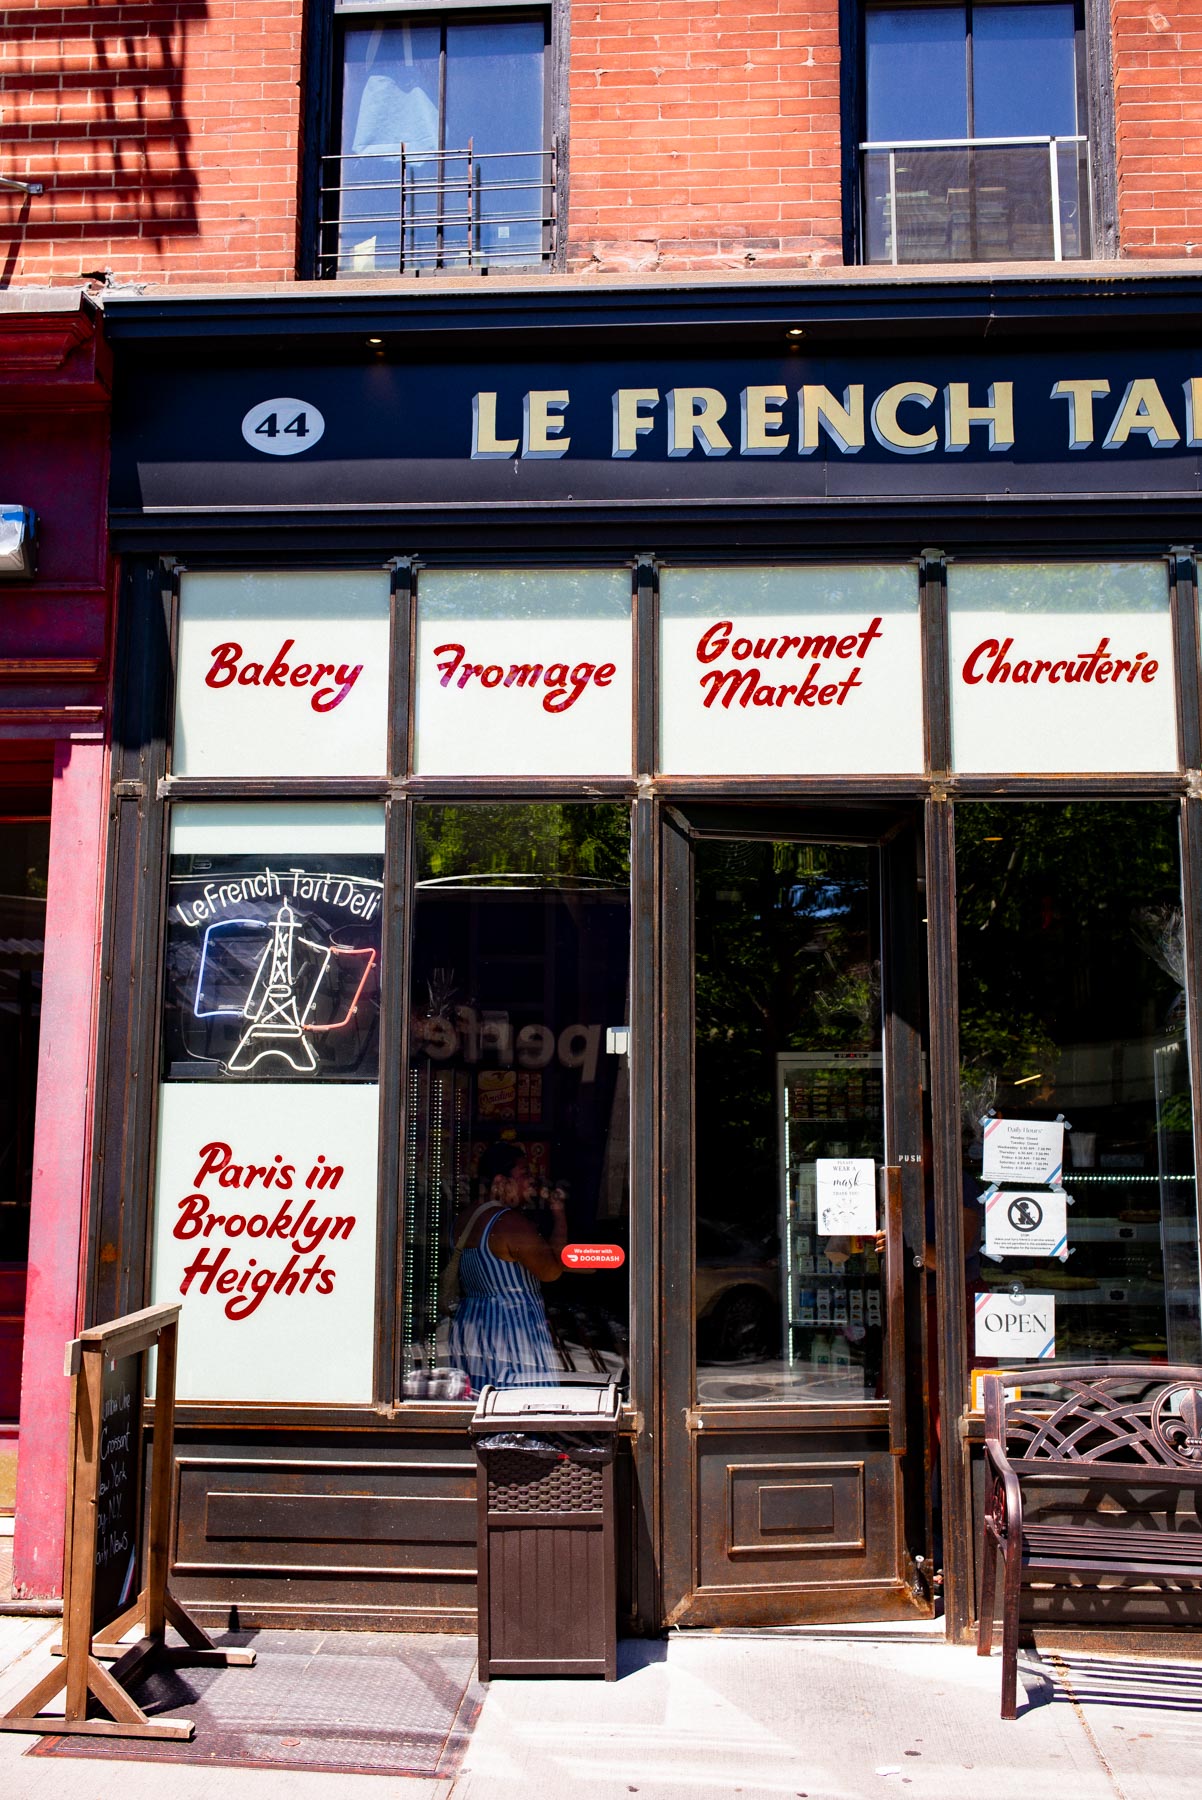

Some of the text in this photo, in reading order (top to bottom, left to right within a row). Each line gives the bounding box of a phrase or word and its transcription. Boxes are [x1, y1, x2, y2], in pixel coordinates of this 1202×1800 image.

[254, 411, 310, 438] 44
[471, 389, 571, 460] LE
[611, 381, 1015, 458] FRENCH
[696, 617, 883, 663] Gourmet
[961, 638, 1158, 685] Charcuterie
[204, 639, 363, 712] Bakery
[433, 643, 616, 713] Fromage
[699, 663, 862, 709] Market
[203, 866, 280, 913] French
[289, 868, 331, 902] Tart
[333, 880, 381, 920] Deli
[193, 1142, 344, 1190] Paris in
[833, 1168, 861, 1189] mask
[172, 1193, 356, 1254] Brooklyn
[179, 1247, 336, 1320] Heights
[985, 1313, 1047, 1333] OPEN
[98, 1459, 128, 1496] ew York
[109, 1530, 129, 1558] News
